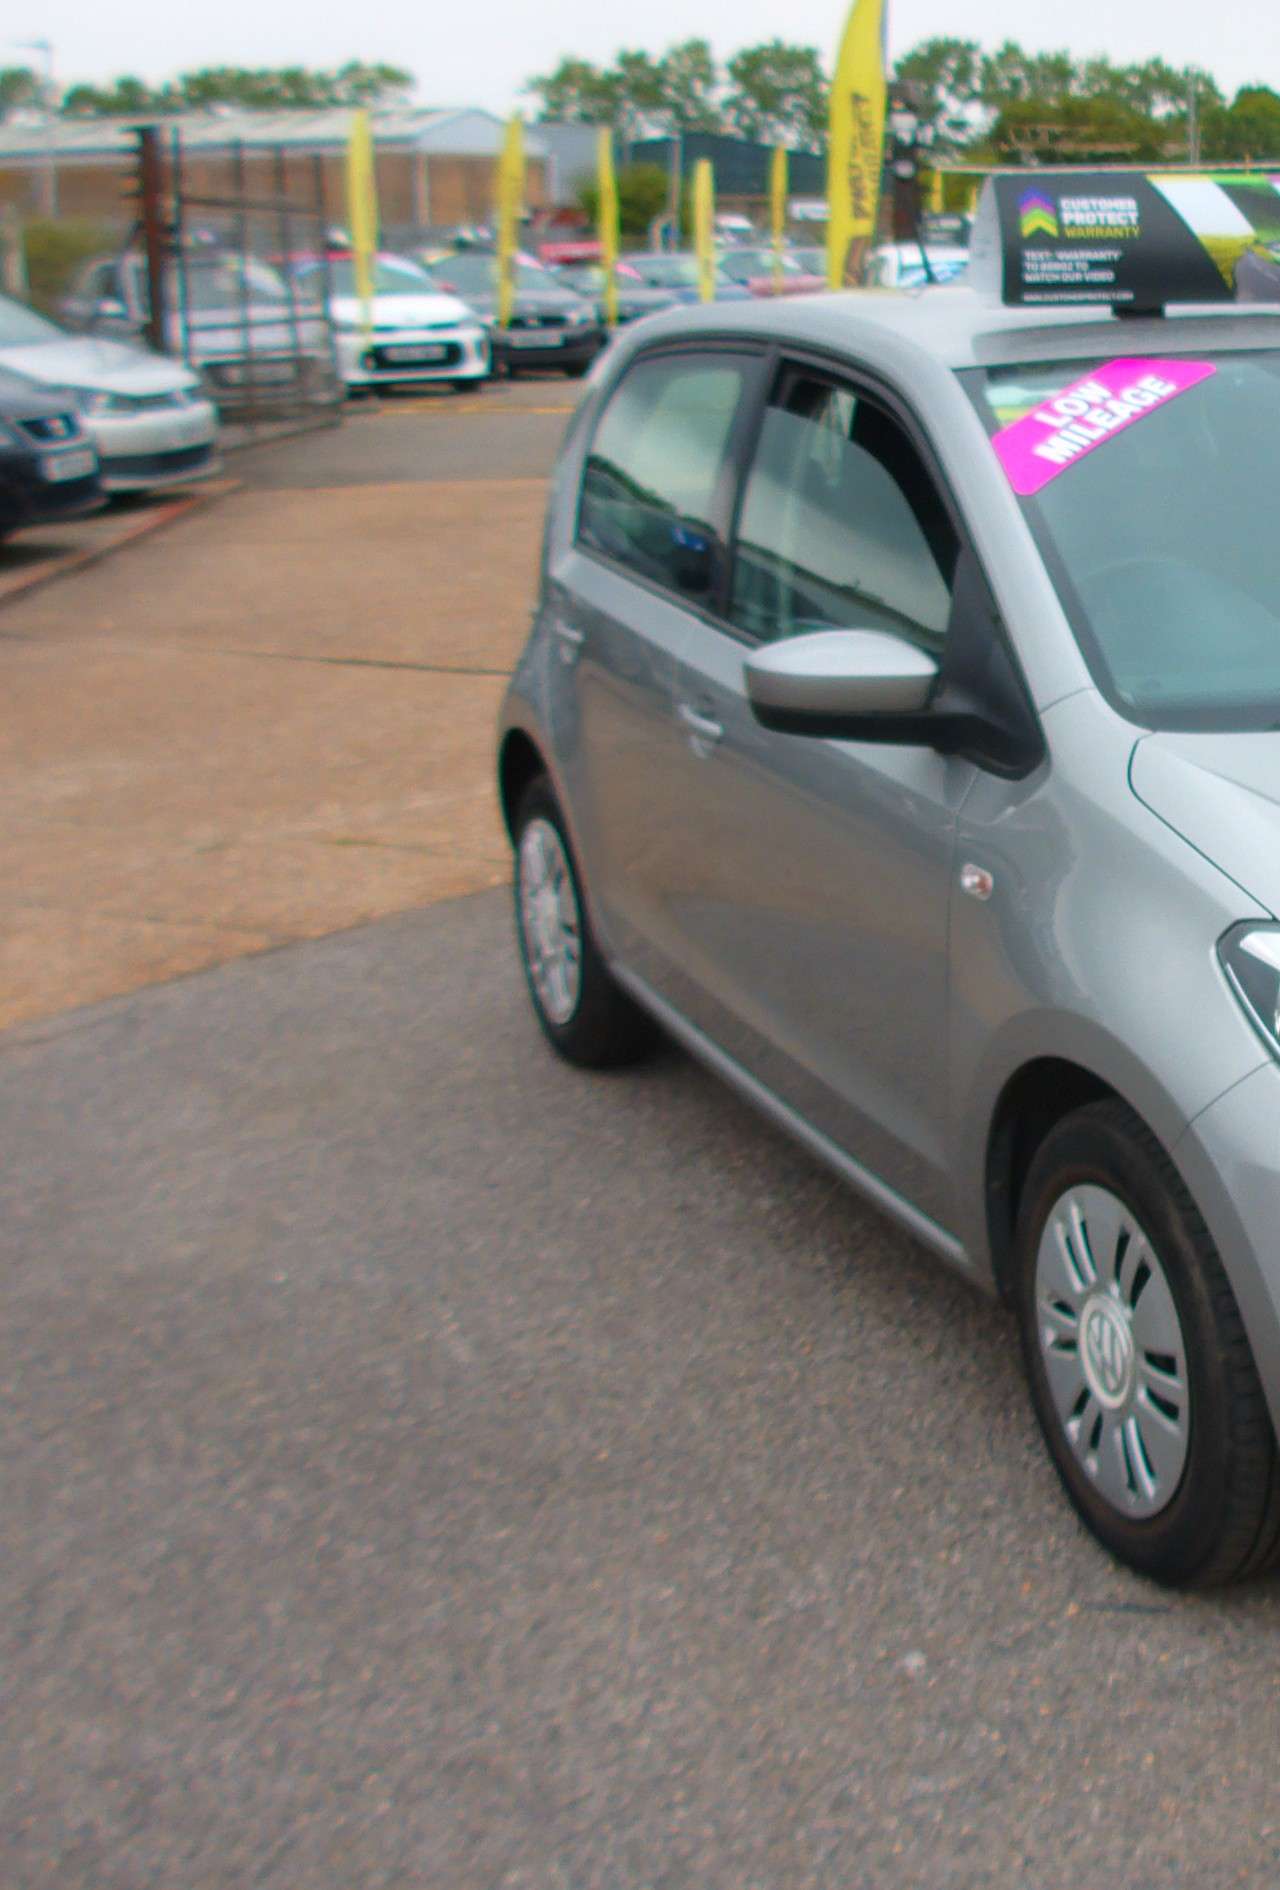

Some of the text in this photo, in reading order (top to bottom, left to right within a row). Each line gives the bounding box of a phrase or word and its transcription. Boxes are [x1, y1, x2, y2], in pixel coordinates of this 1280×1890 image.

[1060, 197, 1137, 211] CUSTOMER
[1062, 211, 1138, 225] PROTECT
[1064, 225, 1141, 239] WARRANTY
[1033, 381, 1113, 427] LOW
[1032, 374, 1177, 464] MILEAGE
